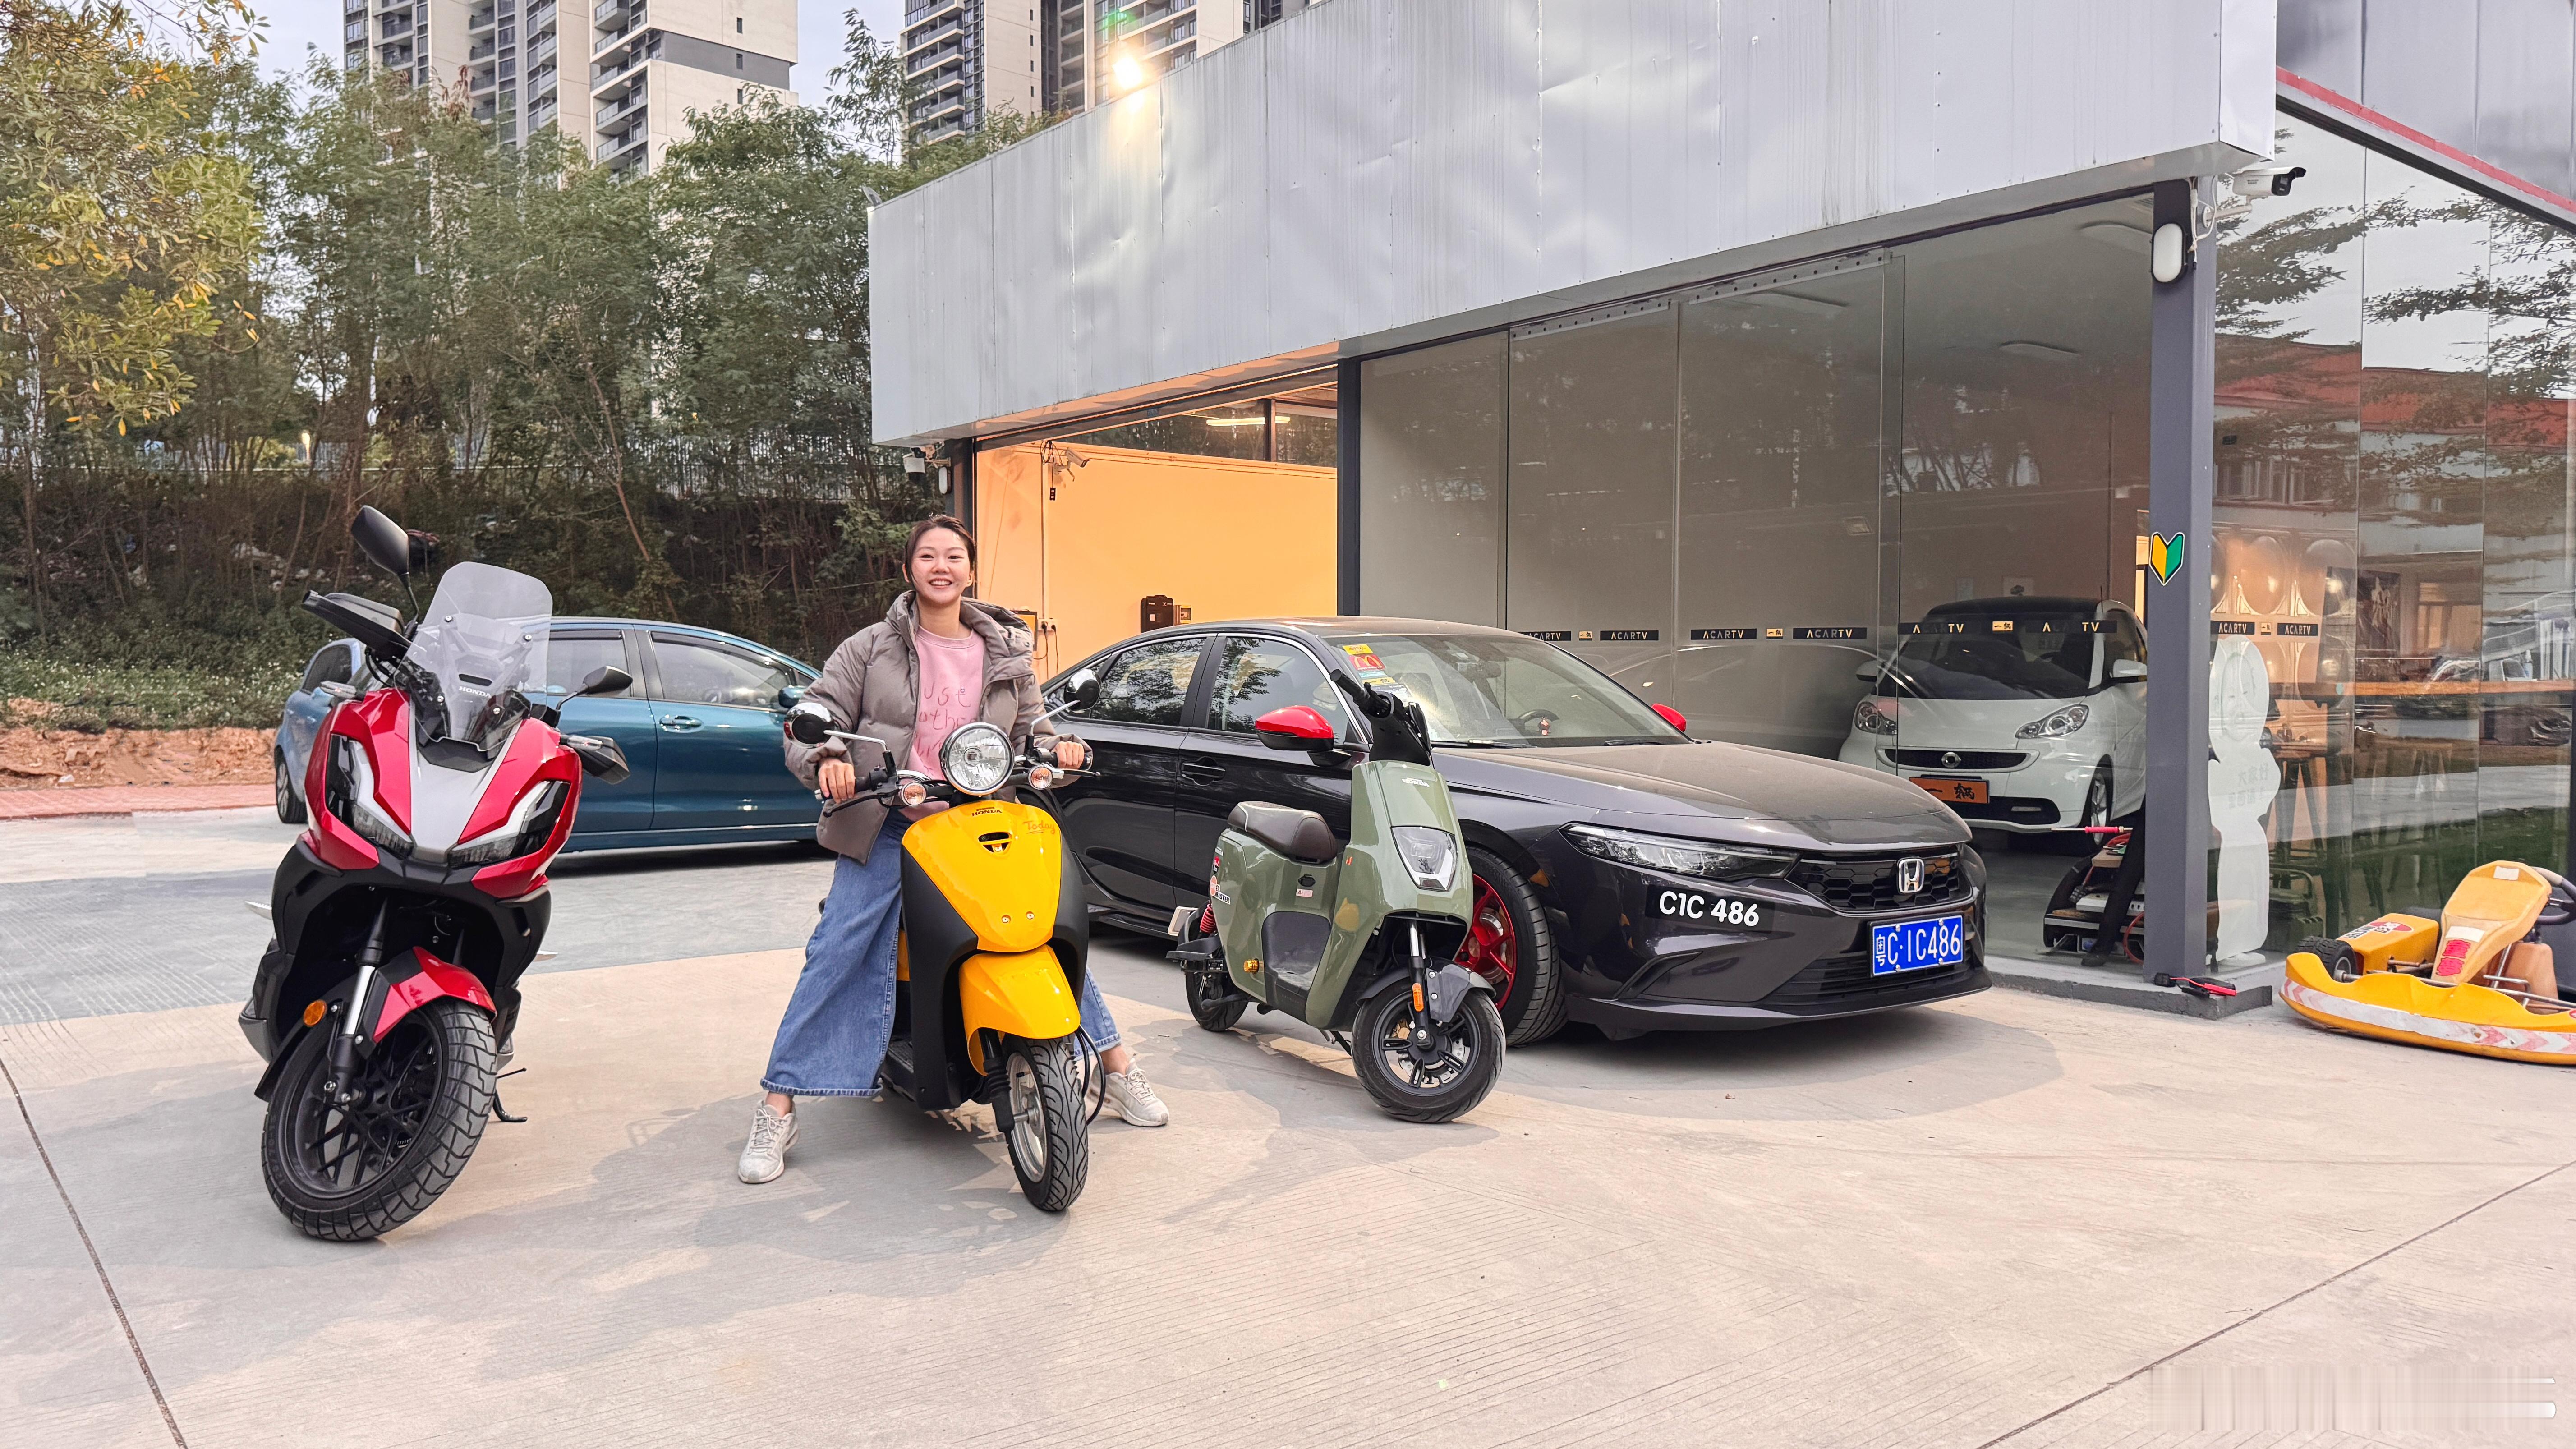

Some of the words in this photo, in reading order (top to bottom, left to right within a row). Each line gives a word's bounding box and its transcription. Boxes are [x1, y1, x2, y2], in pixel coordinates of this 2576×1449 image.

[2219, 623, 2247, 633] ACARTV
[2285, 625, 2311, 635] ACARTV
[1703, 630, 1744, 639] ACARTV
[1807, 630, 1852, 638] ACARTV
[459, 686, 491, 699] HONDA
[1022, 820, 1055, 834] Today
[1660, 891, 1705, 919] C1C
[1711, 899, 1759, 927] 486
